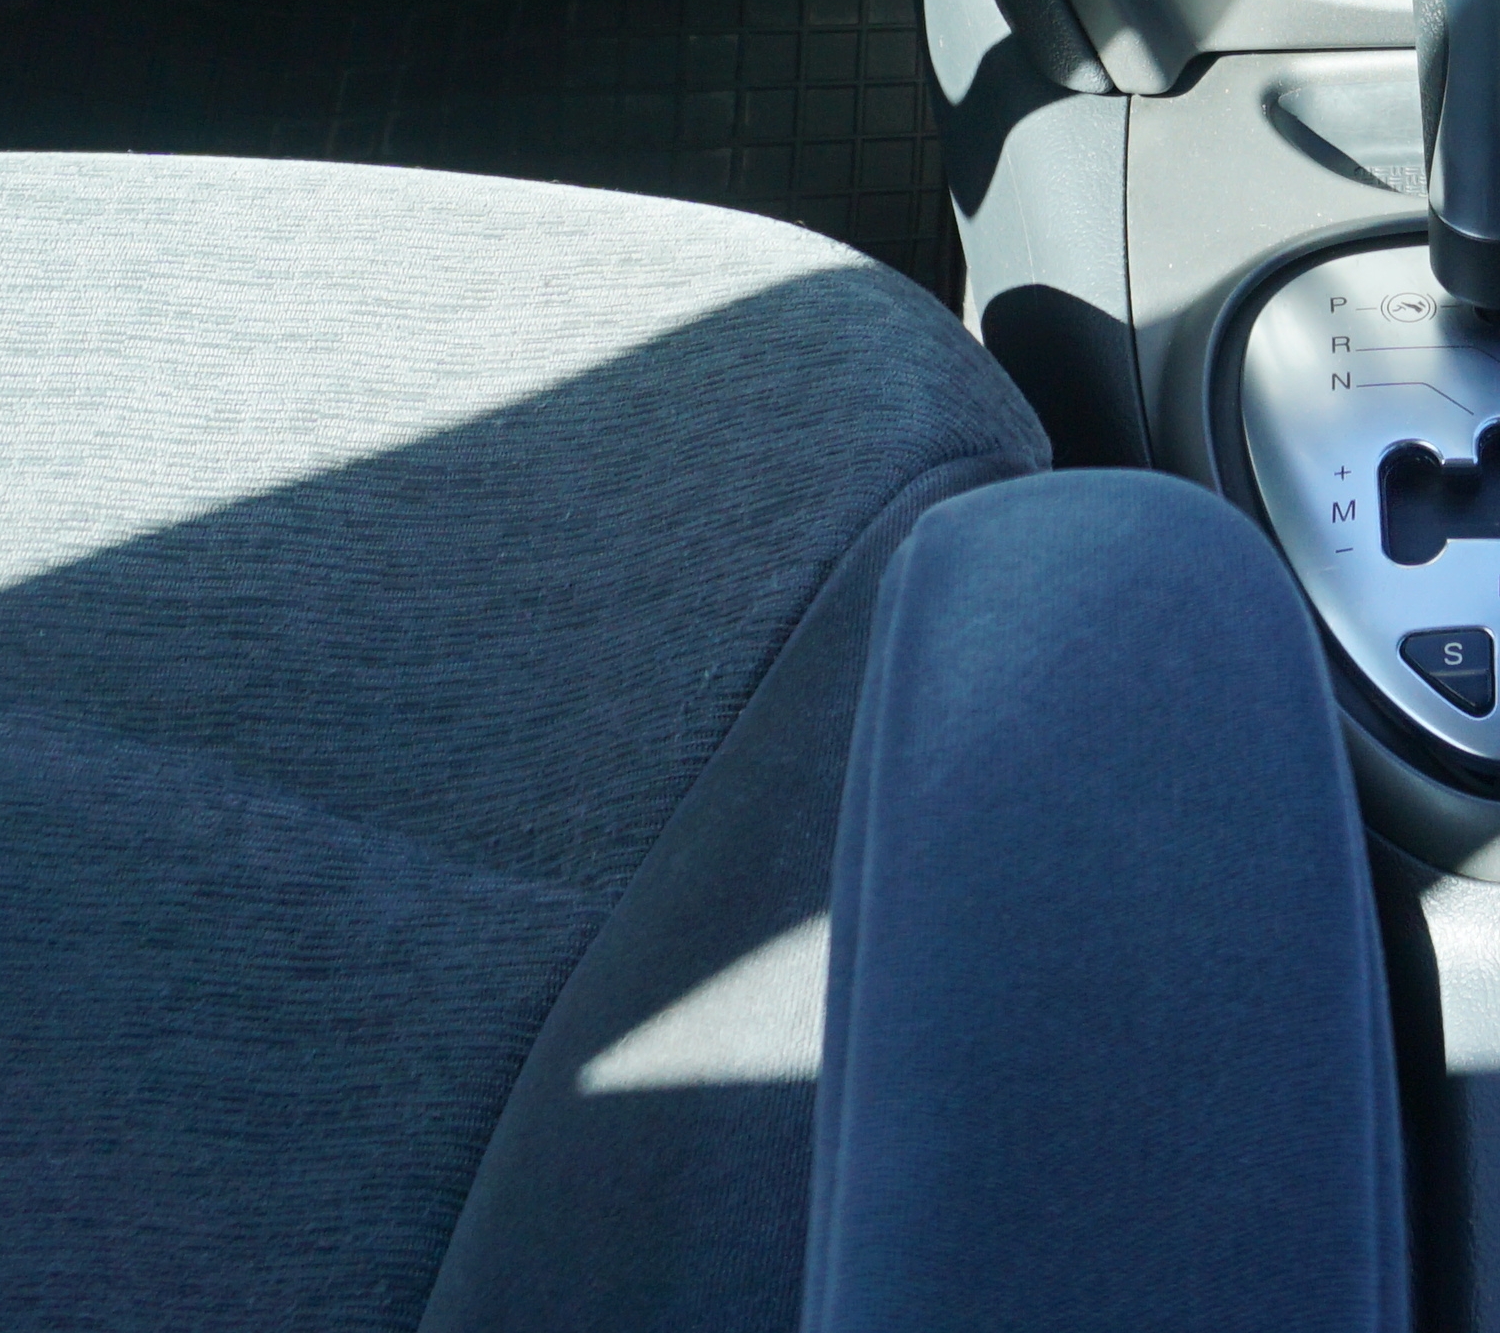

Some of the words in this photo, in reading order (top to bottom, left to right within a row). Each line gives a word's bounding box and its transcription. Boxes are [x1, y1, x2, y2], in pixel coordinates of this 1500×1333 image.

[1330, 296, 1348, 313] P
[1332, 335, 1351, 353] R
[1332, 373, 1352, 391] N
[1332, 500, 1356, 521] M
[1444, 643, 1463, 666] S
